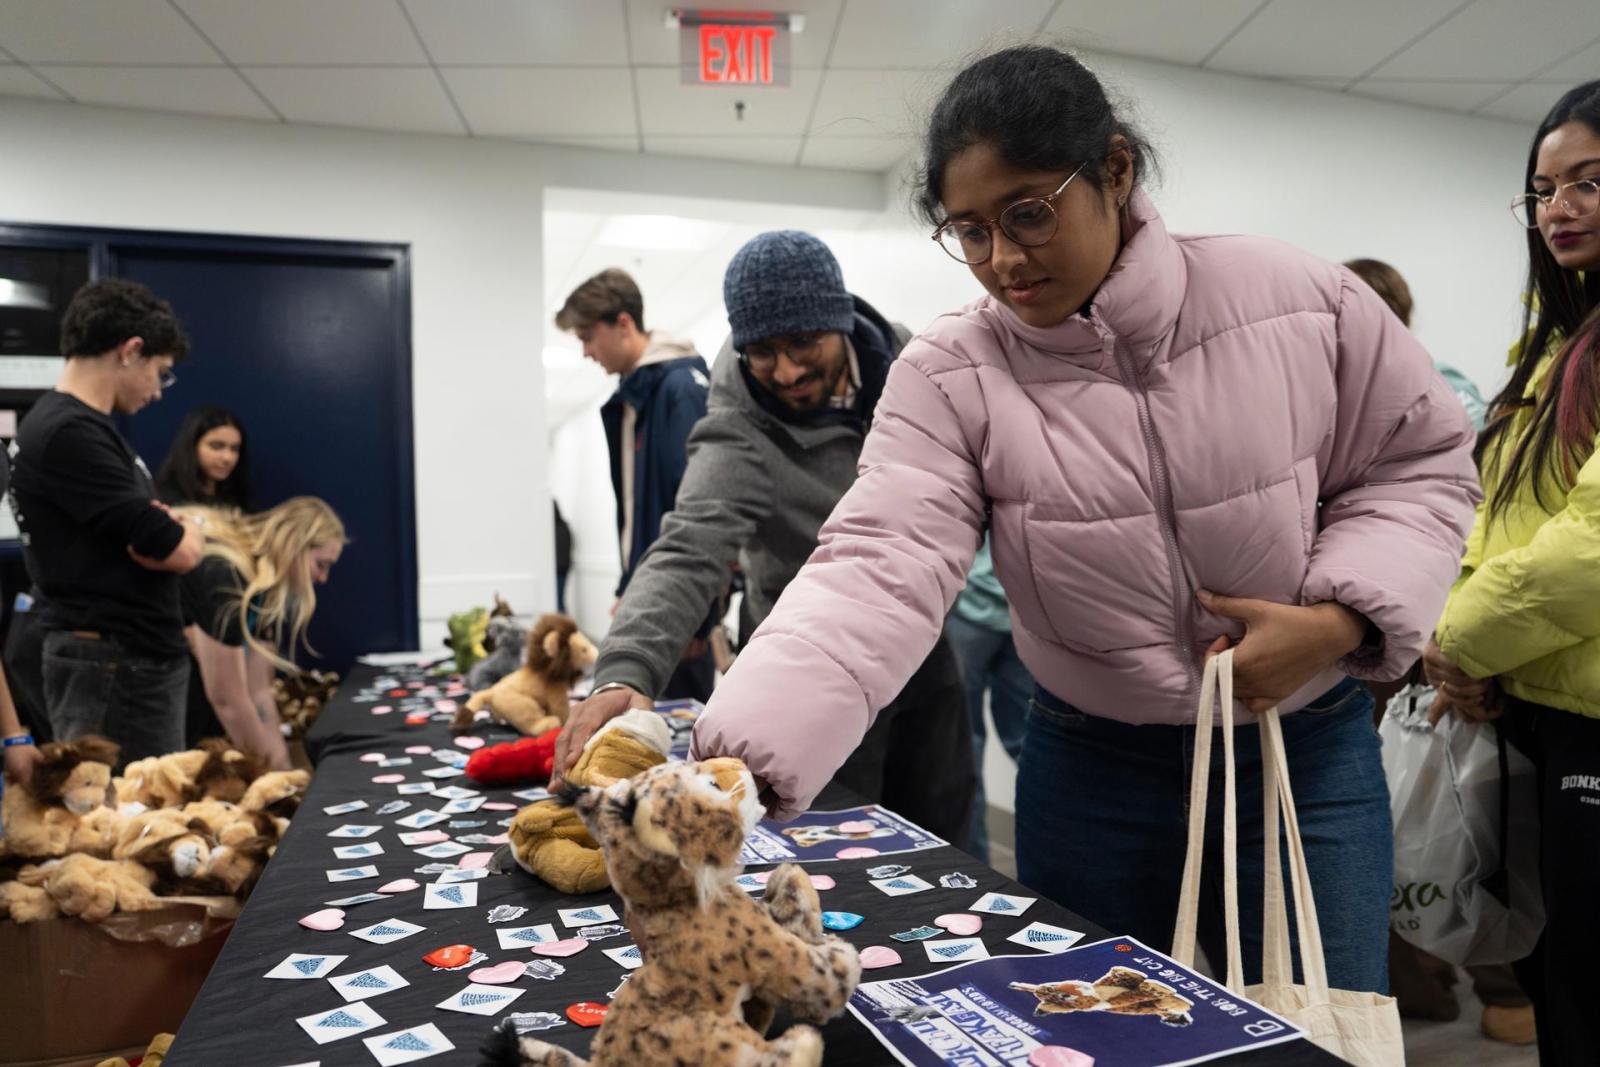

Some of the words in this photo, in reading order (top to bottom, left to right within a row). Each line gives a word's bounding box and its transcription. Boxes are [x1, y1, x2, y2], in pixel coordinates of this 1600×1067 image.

[701, 25, 775, 82] EXIT
[1132, 956, 1164, 971] CAT
[1158, 969, 1186, 983] BIG
[1178, 981, 1212, 1000] THE
[1211, 998, 1248, 1017] BOB
[930, 993, 1032, 1064] REAKFAST
